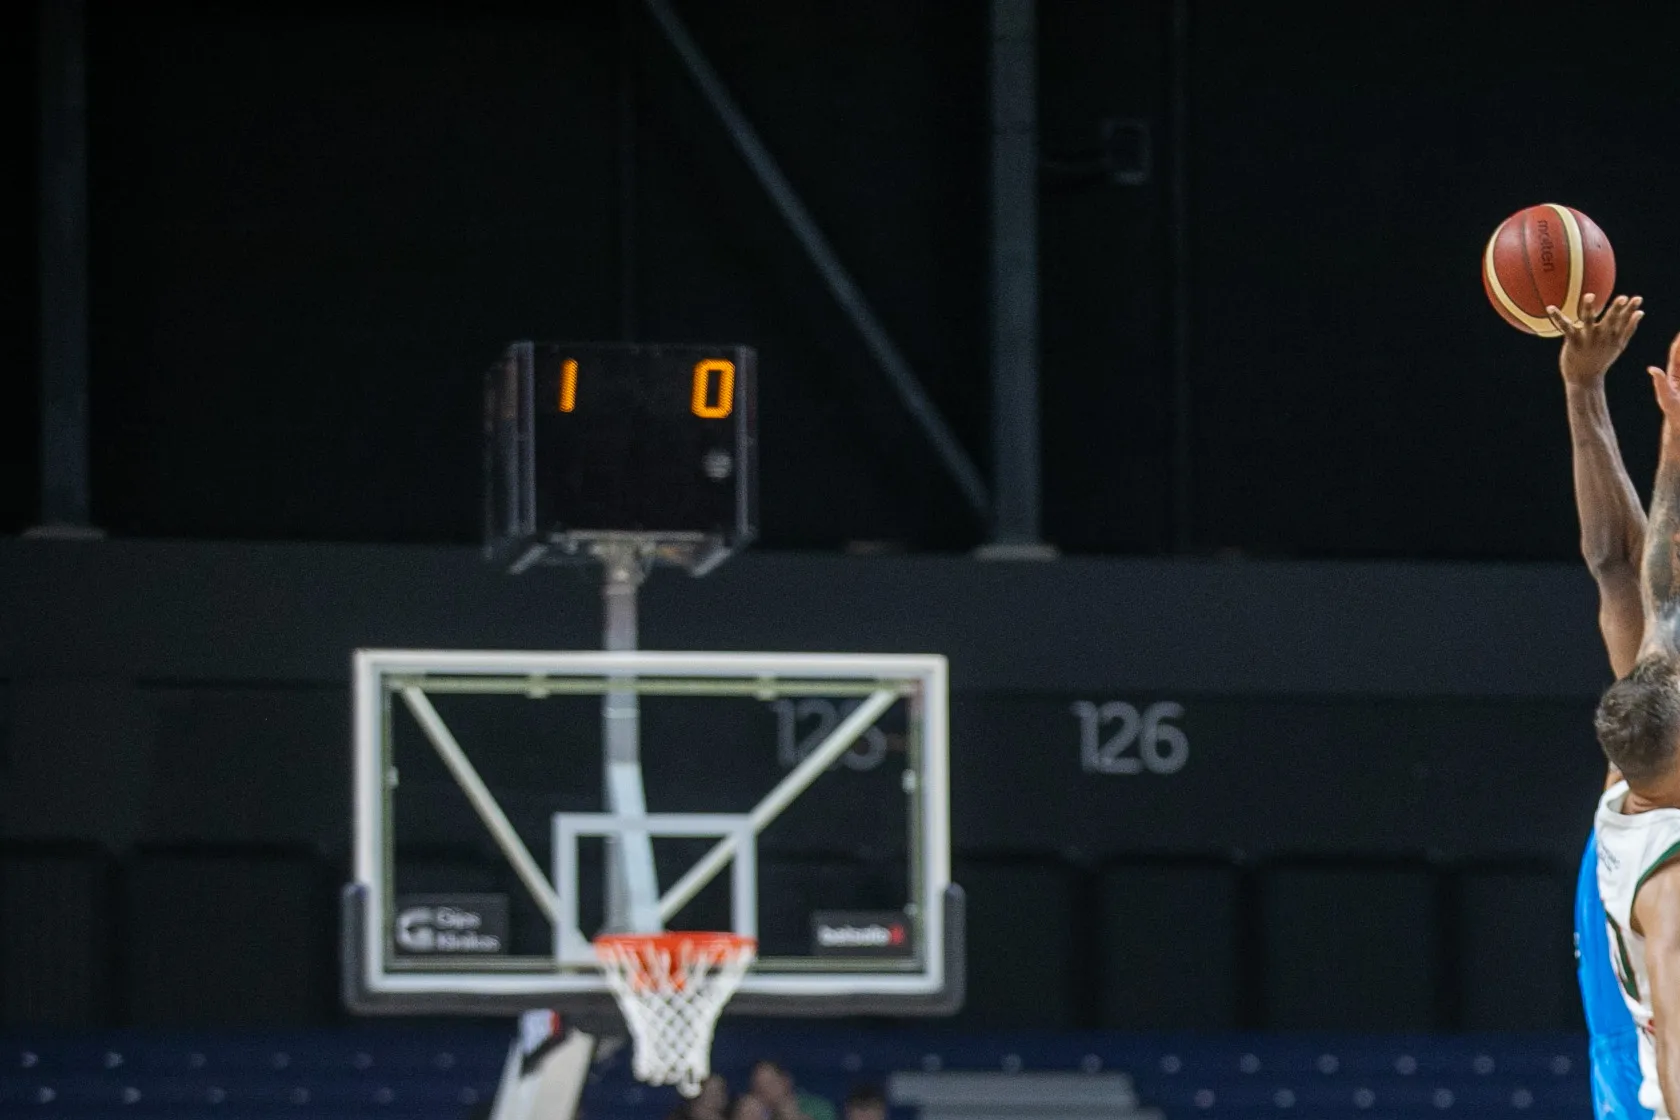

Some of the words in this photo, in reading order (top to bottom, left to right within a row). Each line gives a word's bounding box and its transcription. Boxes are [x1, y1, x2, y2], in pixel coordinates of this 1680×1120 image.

[1537, 219, 1555, 273] molten
[558, 358, 578, 412] 1
[690, 358, 736, 419] 0
[1069, 699, 1190, 774] 126
